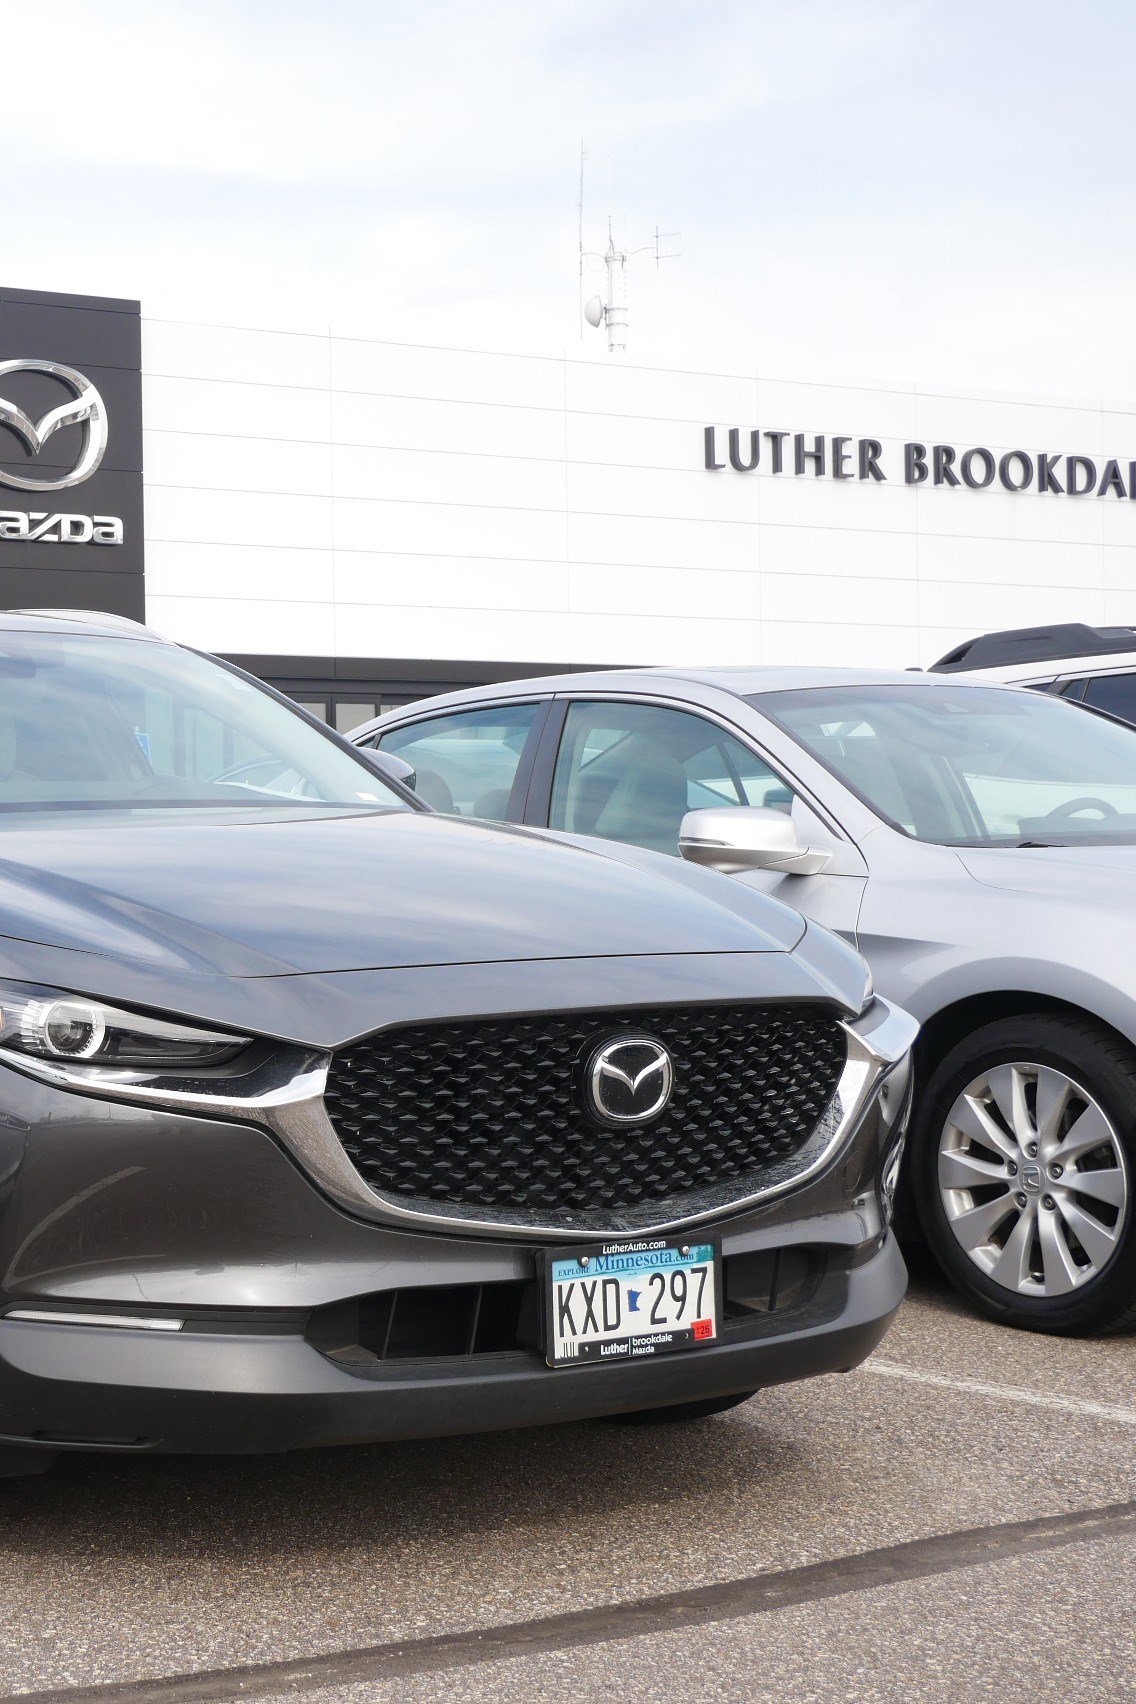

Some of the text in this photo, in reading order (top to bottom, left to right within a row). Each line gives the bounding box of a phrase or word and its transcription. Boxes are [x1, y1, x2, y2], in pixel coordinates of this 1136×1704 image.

[704, 426, 887, 481] LUTHER
[602, 1240, 666, 1254] LutherAuto.com
[558, 1265, 591, 1277] EXPLORE
[557, 1266, 708, 1338] KXD 297
[600, 1333, 673, 1355] Luther brookdale
[632, 1345, 655, 1355] Mazda
